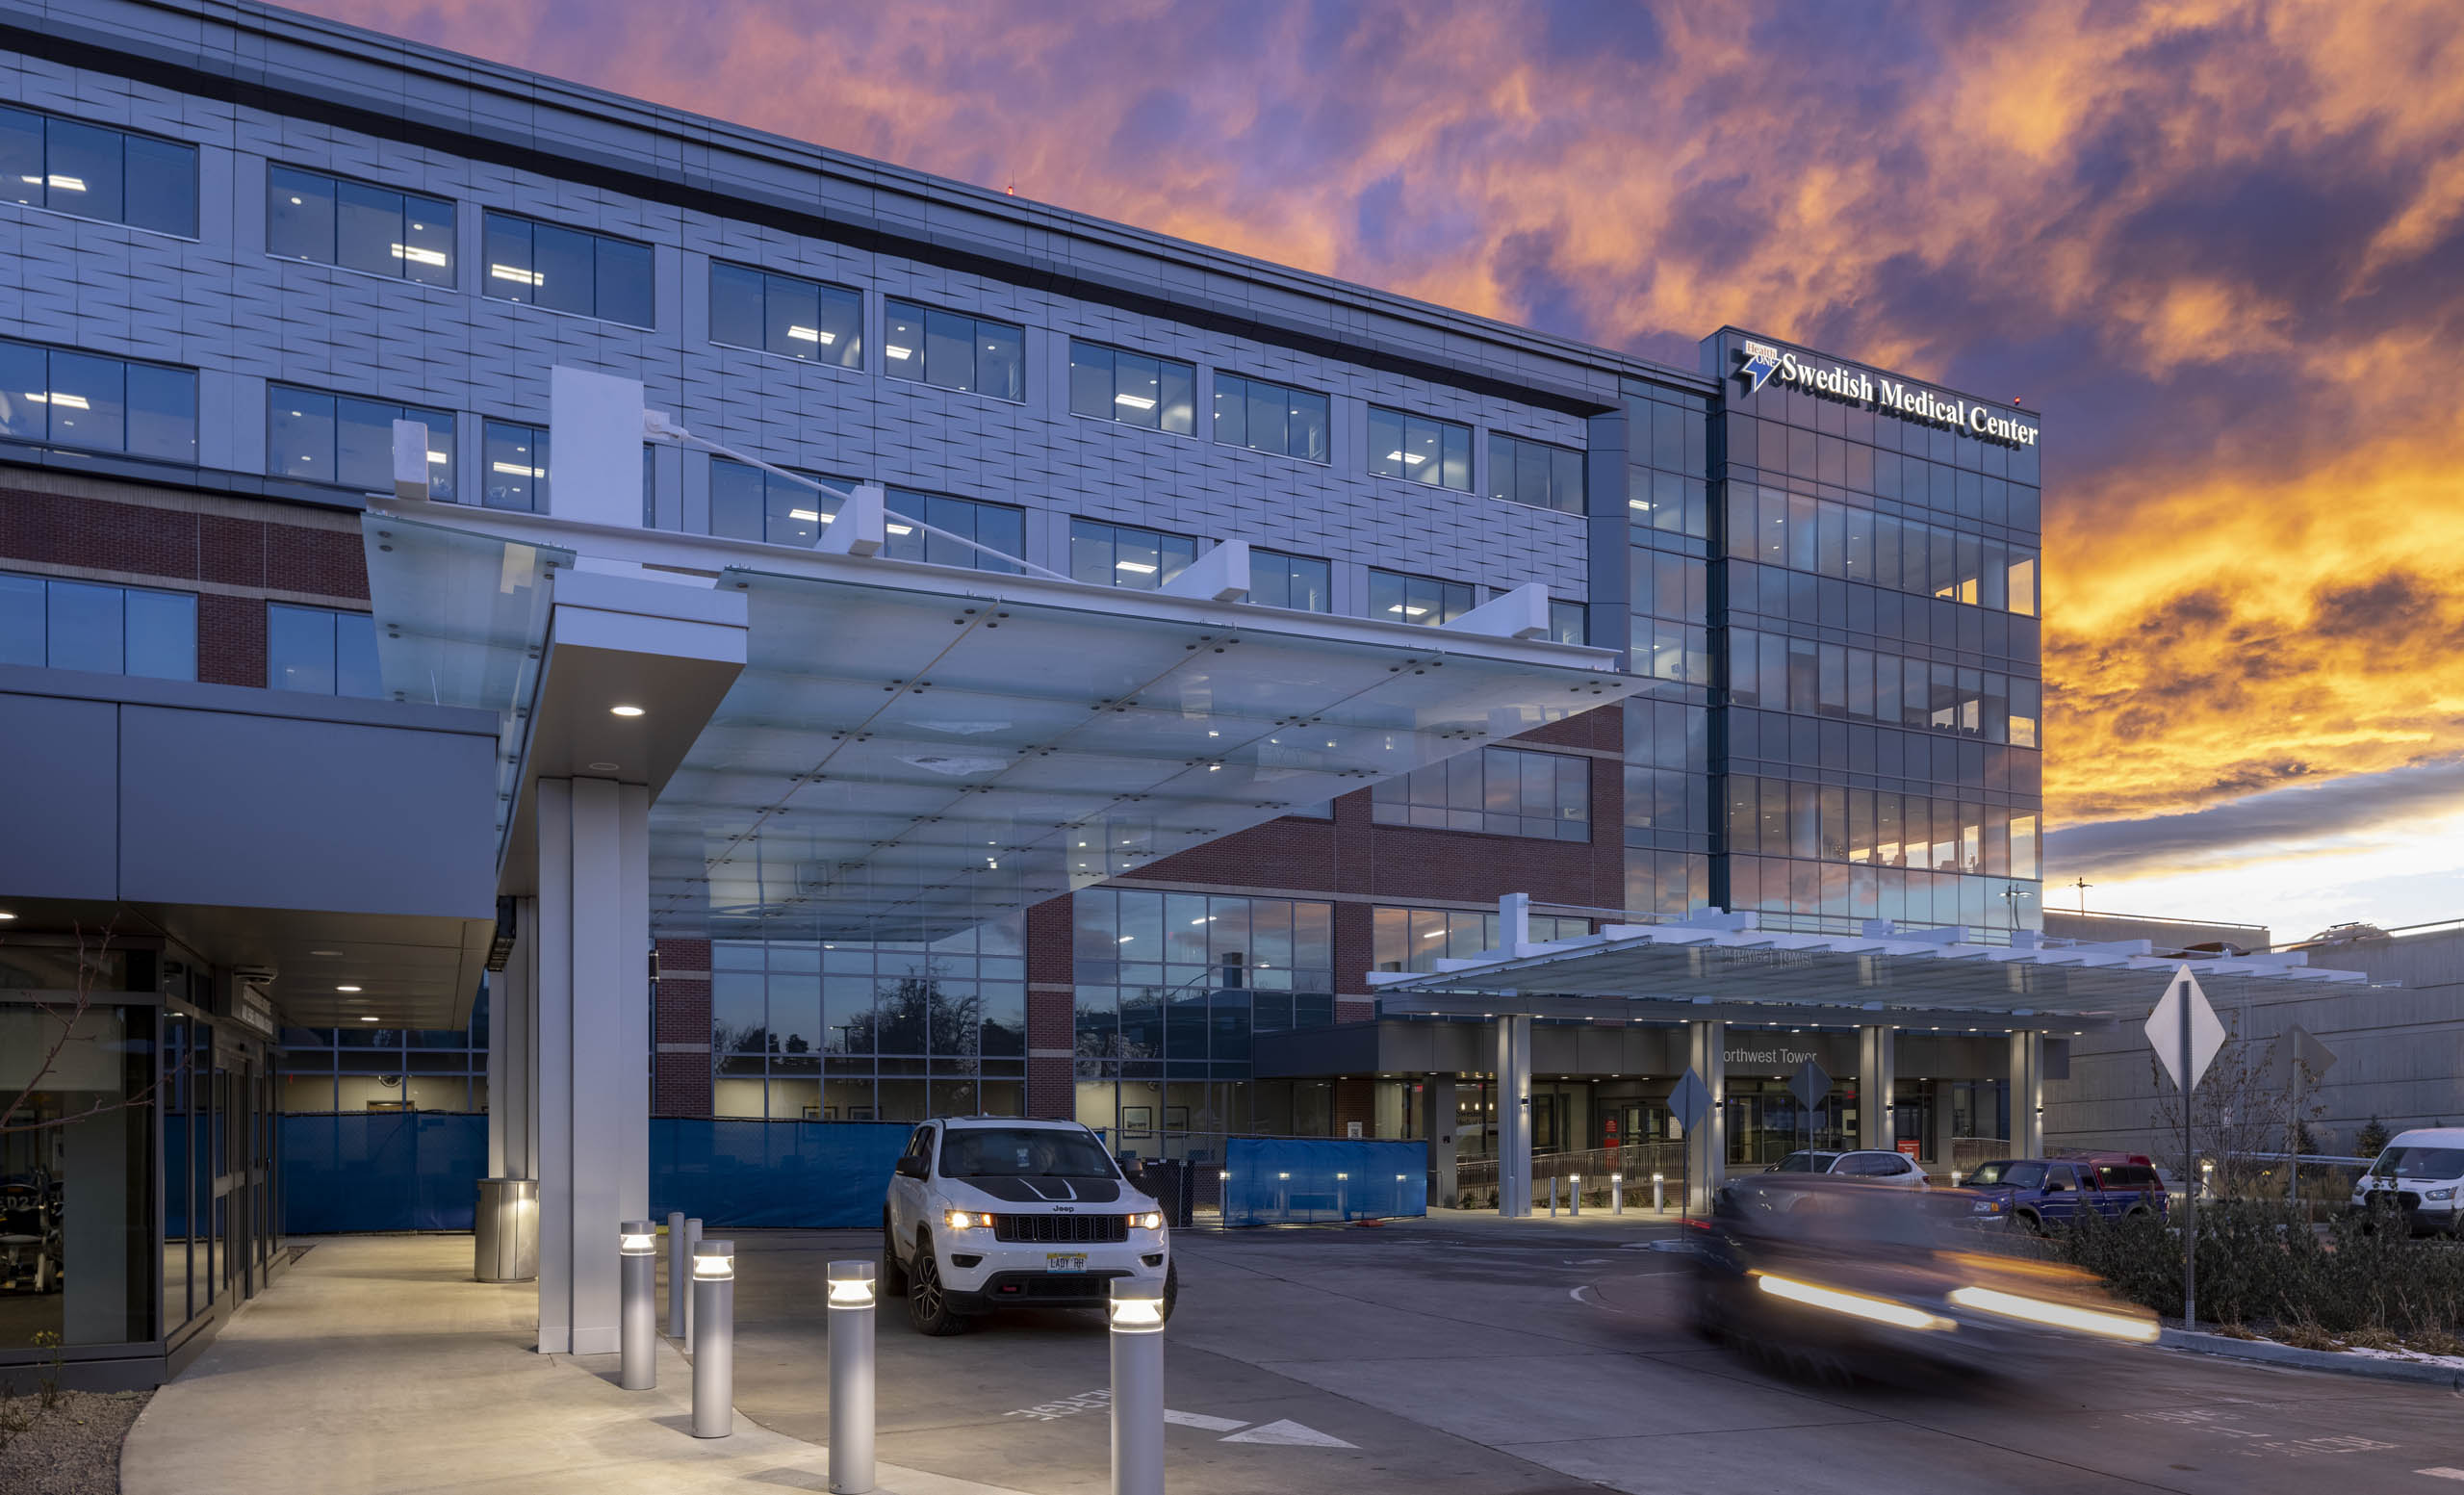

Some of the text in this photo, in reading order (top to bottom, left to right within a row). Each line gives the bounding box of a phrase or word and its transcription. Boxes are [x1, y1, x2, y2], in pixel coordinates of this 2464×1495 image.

[1757, 353, 1778, 368] ONE
[1782, 353, 2039, 446] Swedish Medical Center
[1724, 1047, 1777, 1063] orthwest
